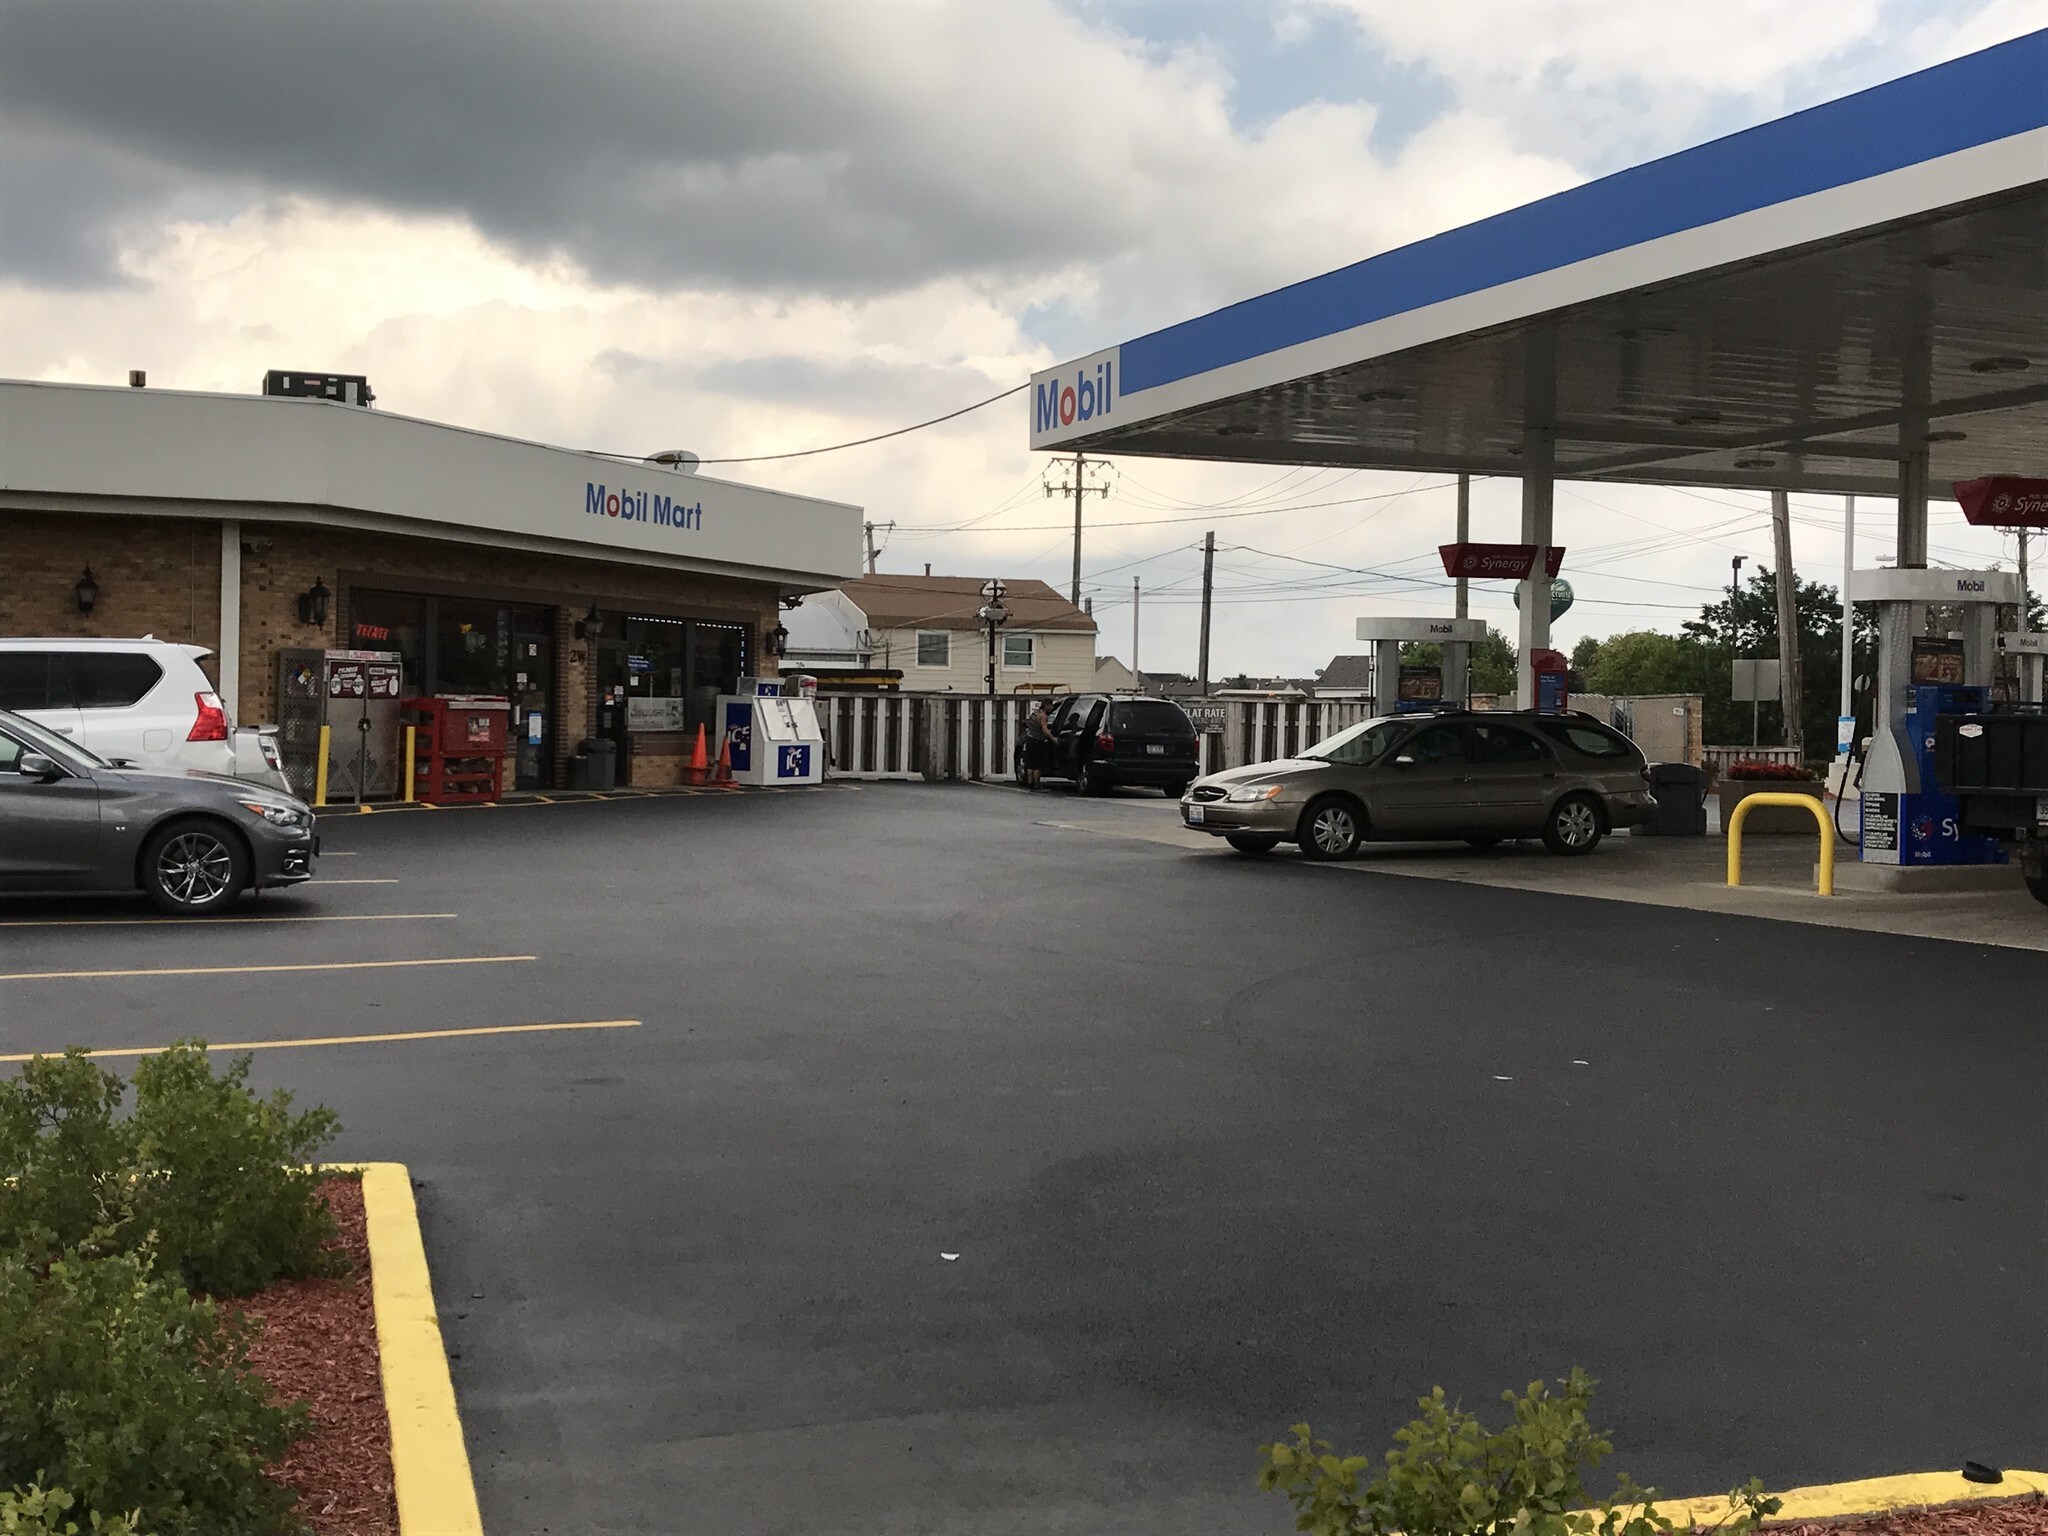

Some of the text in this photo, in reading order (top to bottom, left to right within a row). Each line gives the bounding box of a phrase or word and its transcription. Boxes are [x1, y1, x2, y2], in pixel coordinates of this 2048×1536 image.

[1037, 361, 1112, 433] Mobil
[586, 482, 702, 531] Mobil Mart
[1547, 551, 1554, 561] 2
[1481, 557, 1528, 572] Synergy
[1957, 580, 1985, 592] Mobil
[1430, 624, 1453, 633] Mobil
[2020, 639, 2038, 647] Mobil
[1204, 708, 1225, 718] RATE
[786, 748, 802, 771] ICE
